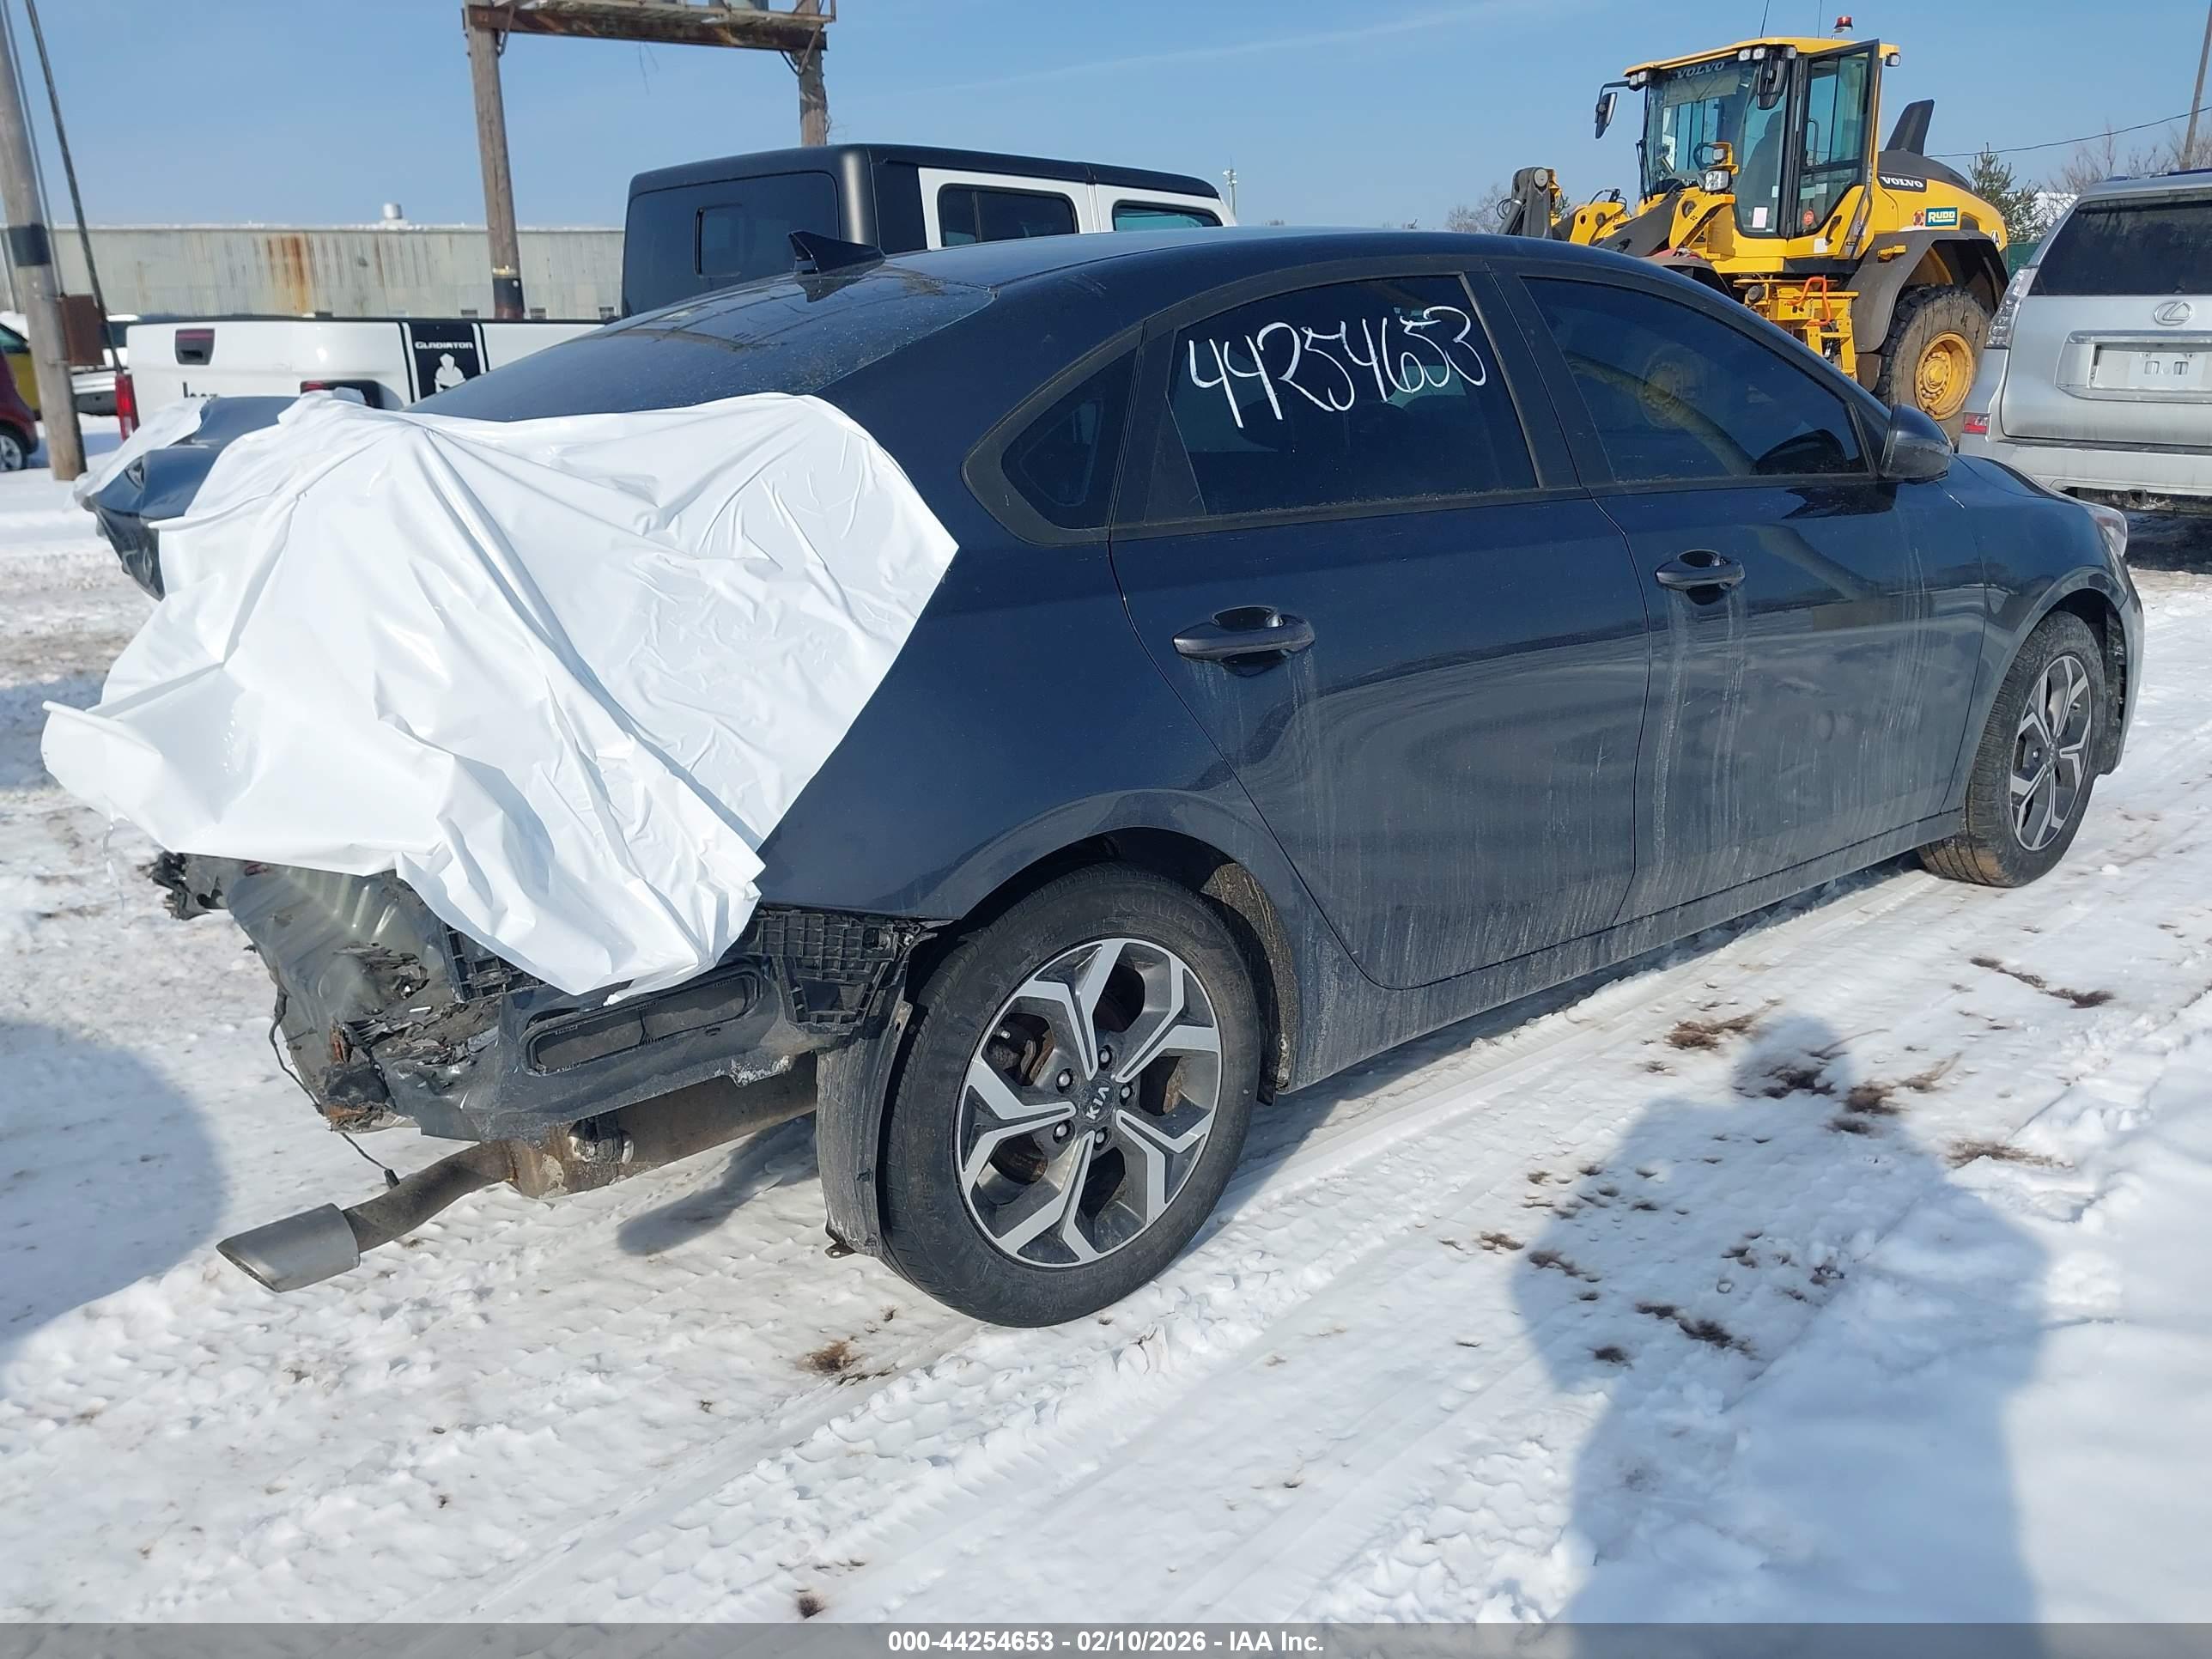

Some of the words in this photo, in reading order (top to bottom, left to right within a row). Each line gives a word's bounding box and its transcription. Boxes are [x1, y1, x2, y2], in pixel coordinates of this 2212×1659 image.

[1676, 61, 1725, 79] VOLVO
[1880, 176, 1924, 188] VOLVO
[1928, 210, 1955, 223] RUDD
[414, 341, 474, 349] GLADIATOR
[1188, 306, 1486, 428] 44254653
